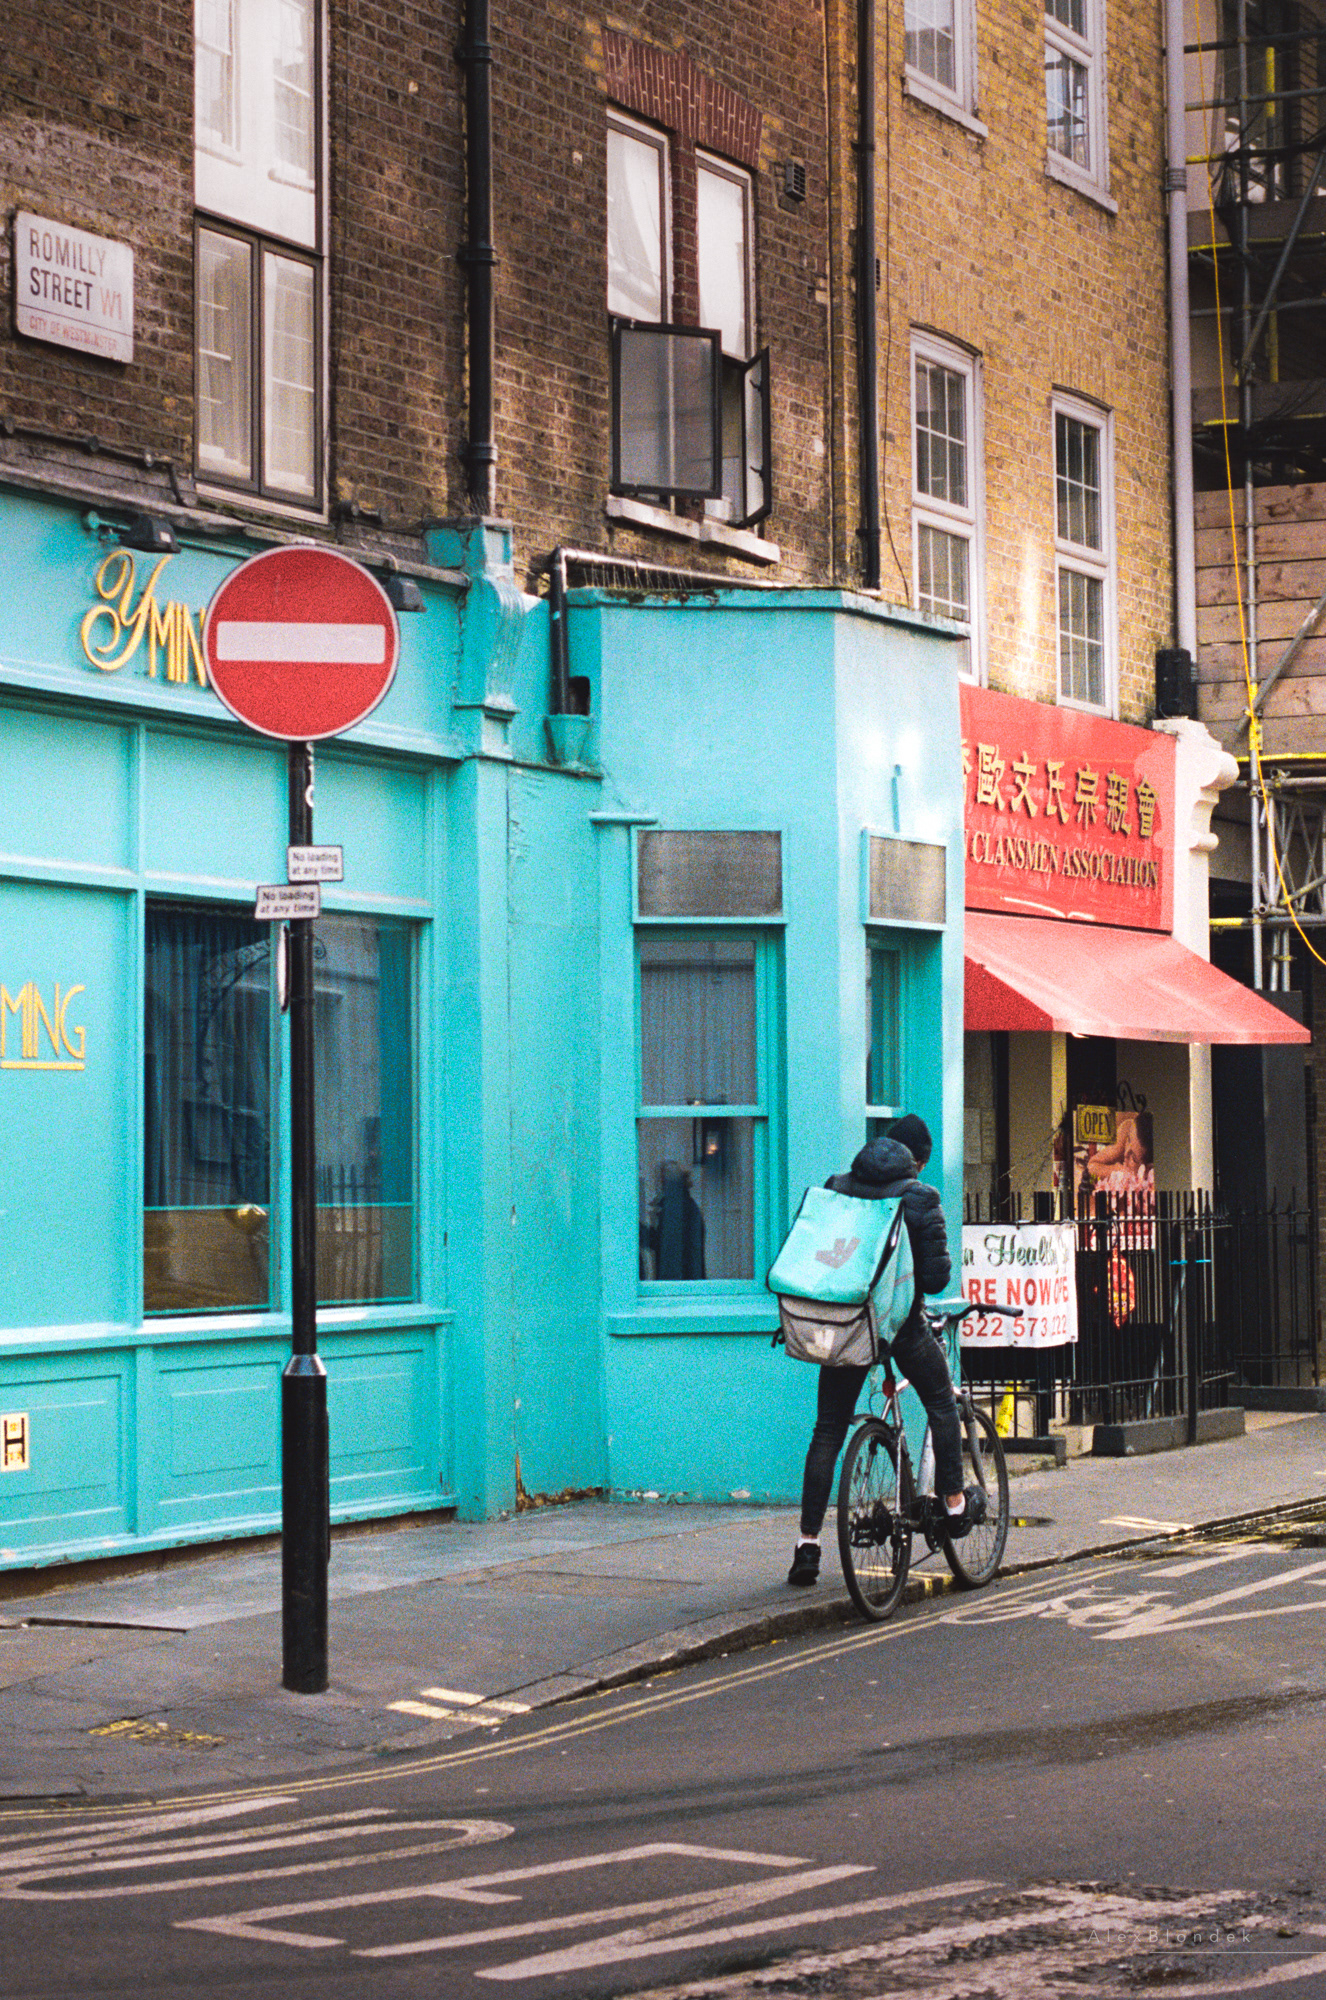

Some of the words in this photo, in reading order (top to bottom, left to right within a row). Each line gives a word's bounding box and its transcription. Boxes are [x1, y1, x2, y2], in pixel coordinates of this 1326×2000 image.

[29, 227, 106, 278] ROMILLY
[30, 266, 93, 311] STREET
[100, 287, 122, 320] W1
[29, 315, 47, 332] CITY
[50, 321, 60, 335] OF
[293, 852, 305, 862] No
[308, 852, 338, 863] loading
[972, 831, 1058, 874] CLANSMEN
[1061, 848, 1159, 888] ASSOCIATION
[292, 866, 301, 875] at
[304, 867, 318, 876] any
[321, 866, 339, 875] time
[263, 892, 276, 901] No
[279, 891, 315, 901] loading
[260, 905, 270, 914] at
[273, 906, 290, 915] any
[294, 904, 316, 913] time
[1084, 1111, 1112, 1137] OPEN
[1007, 1278, 1051, 1306] NOW
